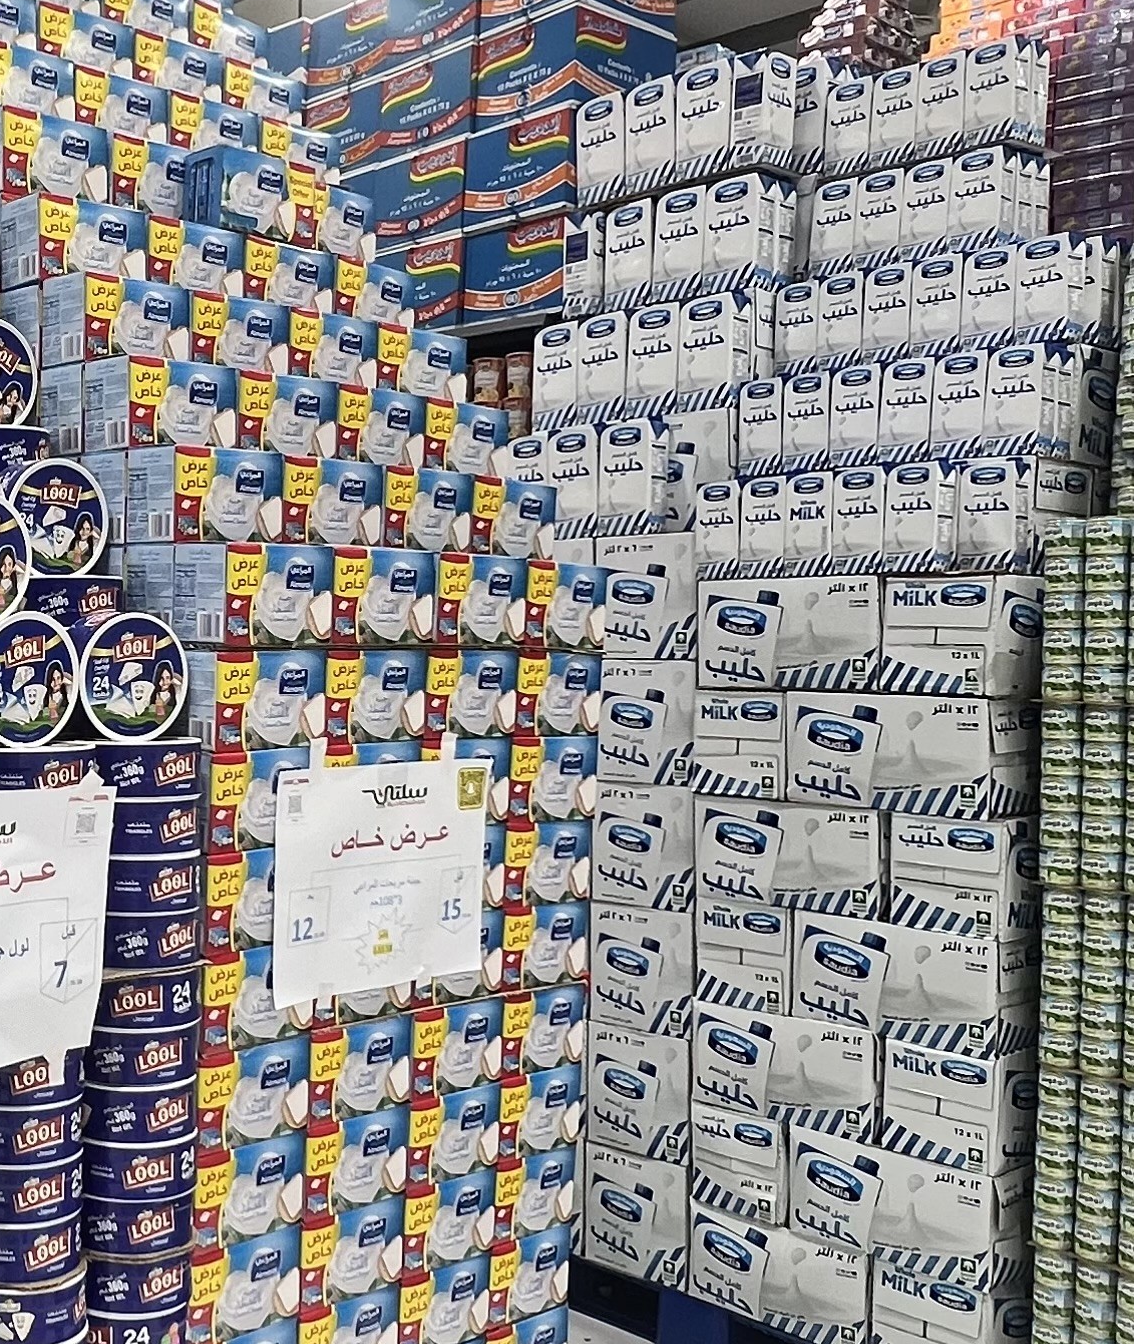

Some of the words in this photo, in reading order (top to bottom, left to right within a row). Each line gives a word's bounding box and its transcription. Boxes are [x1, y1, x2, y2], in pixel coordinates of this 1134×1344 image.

[969, 72, 1010, 92] حليب
[680, 98, 722, 121] حليب
[9, 120, 35, 132] عرض
[8, 135, 35, 147] خاص
[580, 128, 617, 149] حليب
[708, 213, 750, 233] حليب
[968, 279, 1011, 299] حليب
[683, 329, 725, 351] حليب
[991, 380, 1037, 399] حليب
[603, 457, 644, 476] حليب
[790, 505, 825, 522] MiLK
[837, 500, 878, 518] حليب
[964, 497, 1009, 515] حليب
[233, 558, 259, 573] عرض
[231, 575, 258, 590] خاص
[893, 589, 937, 606] MiLK
[115, 639, 153, 659] LOOL
[224, 666, 251, 681] عرض
[705, 657, 766, 682] حليب
[92, 677, 110, 692] 24
[223, 685, 250, 699] خاص
[701, 704, 738, 721] MiLK
[516, 751, 538, 764] عرض
[515, 763, 538, 776] خاص
[794, 771, 862, 801] حليب
[331, 826, 384, 857] خاص
[390, 824, 449, 851] عرض
[899, 831, 945, 848] حليب
[703, 911, 740, 930] MiLK
[9, 937, 29, 956] لول
[54, 960, 68, 988] 7
[596, 984, 645, 1016] حليب
[799, 990, 870, 1027] حليب
[892, 1052, 937, 1077] MiLK
[204, 1070, 231, 1087] عرض
[203, 1086, 232, 1104] خاص
[696, 1076, 758, 1111] حليب
[17, 1124, 60, 1148] LOOL
[311, 1137, 336, 1154] عرض
[310, 1155, 336, 1172] خاص
[794, 1207, 861, 1248] حليب
[881, 1269, 927, 1299] MiLK
